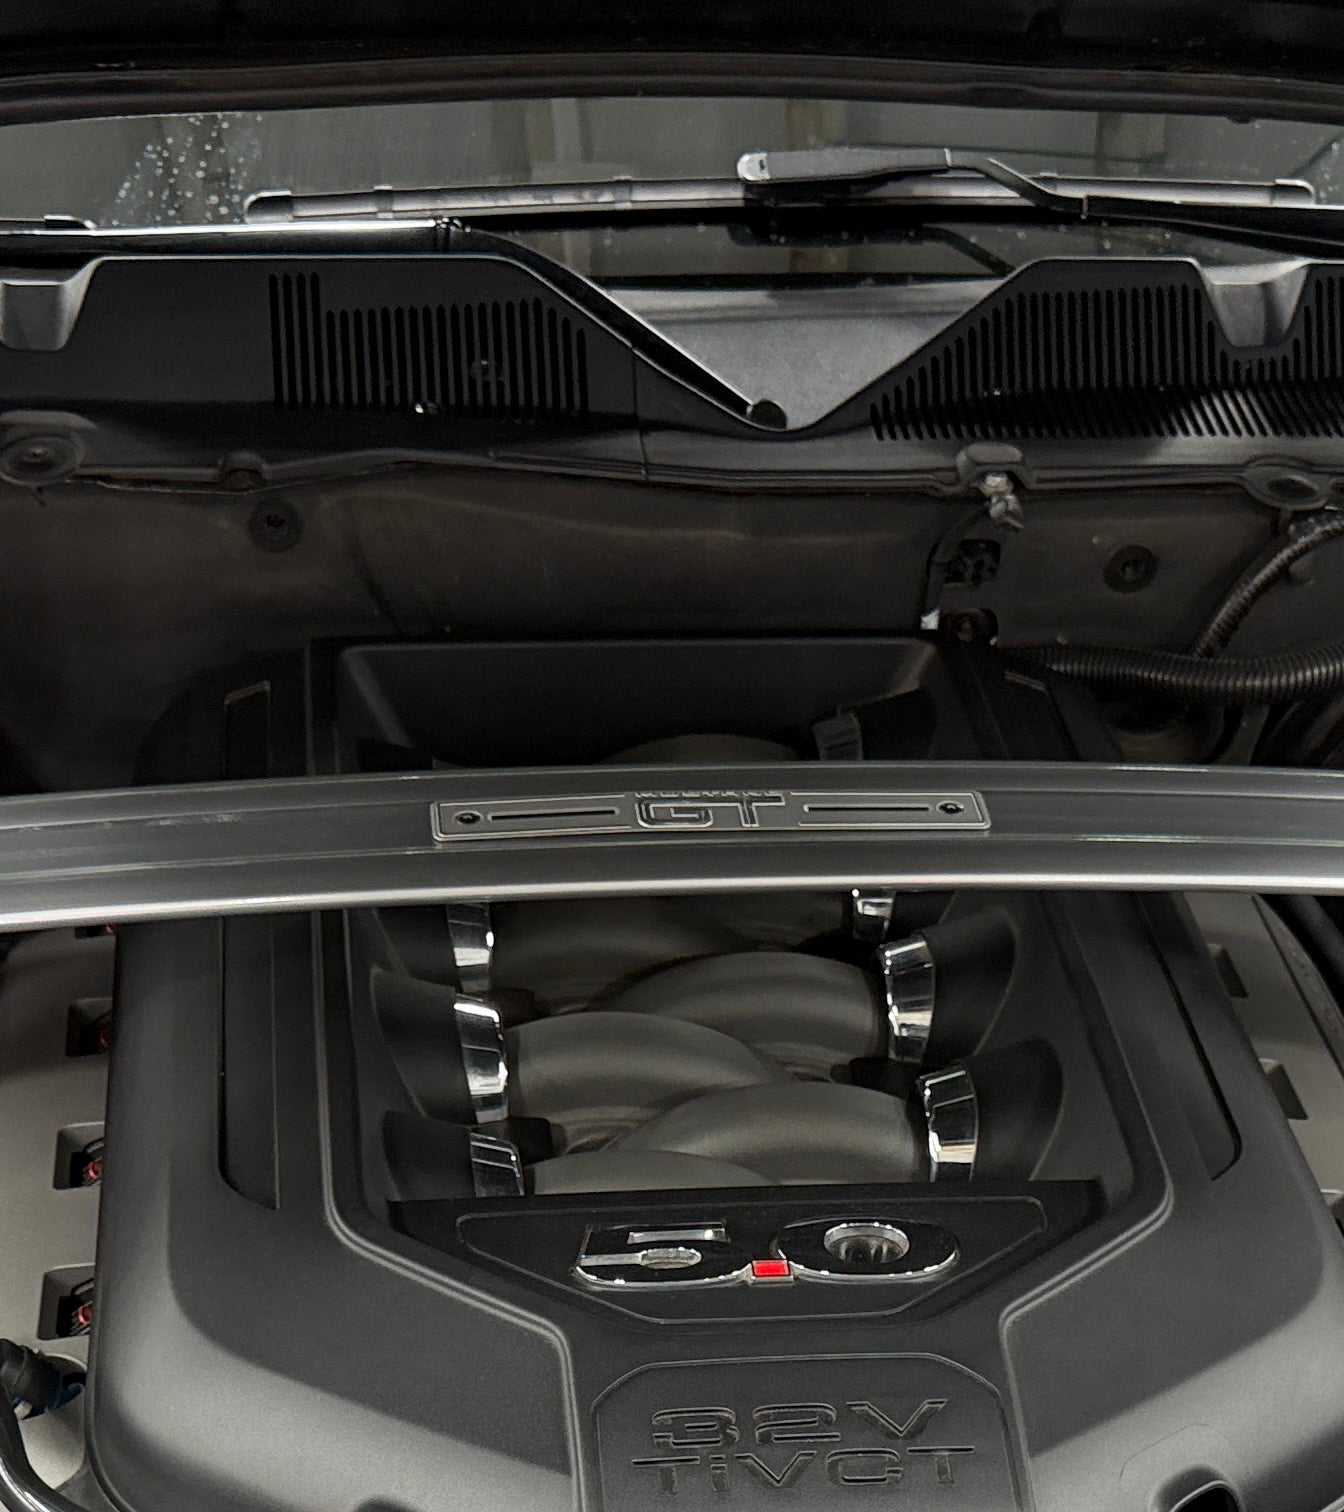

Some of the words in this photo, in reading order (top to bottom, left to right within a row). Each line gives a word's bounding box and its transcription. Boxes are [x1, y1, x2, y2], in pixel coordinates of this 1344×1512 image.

[634, 796, 786, 828] GT
[573, 1216, 960, 1288] 5.0
[651, 1397, 949, 1448] 32V
